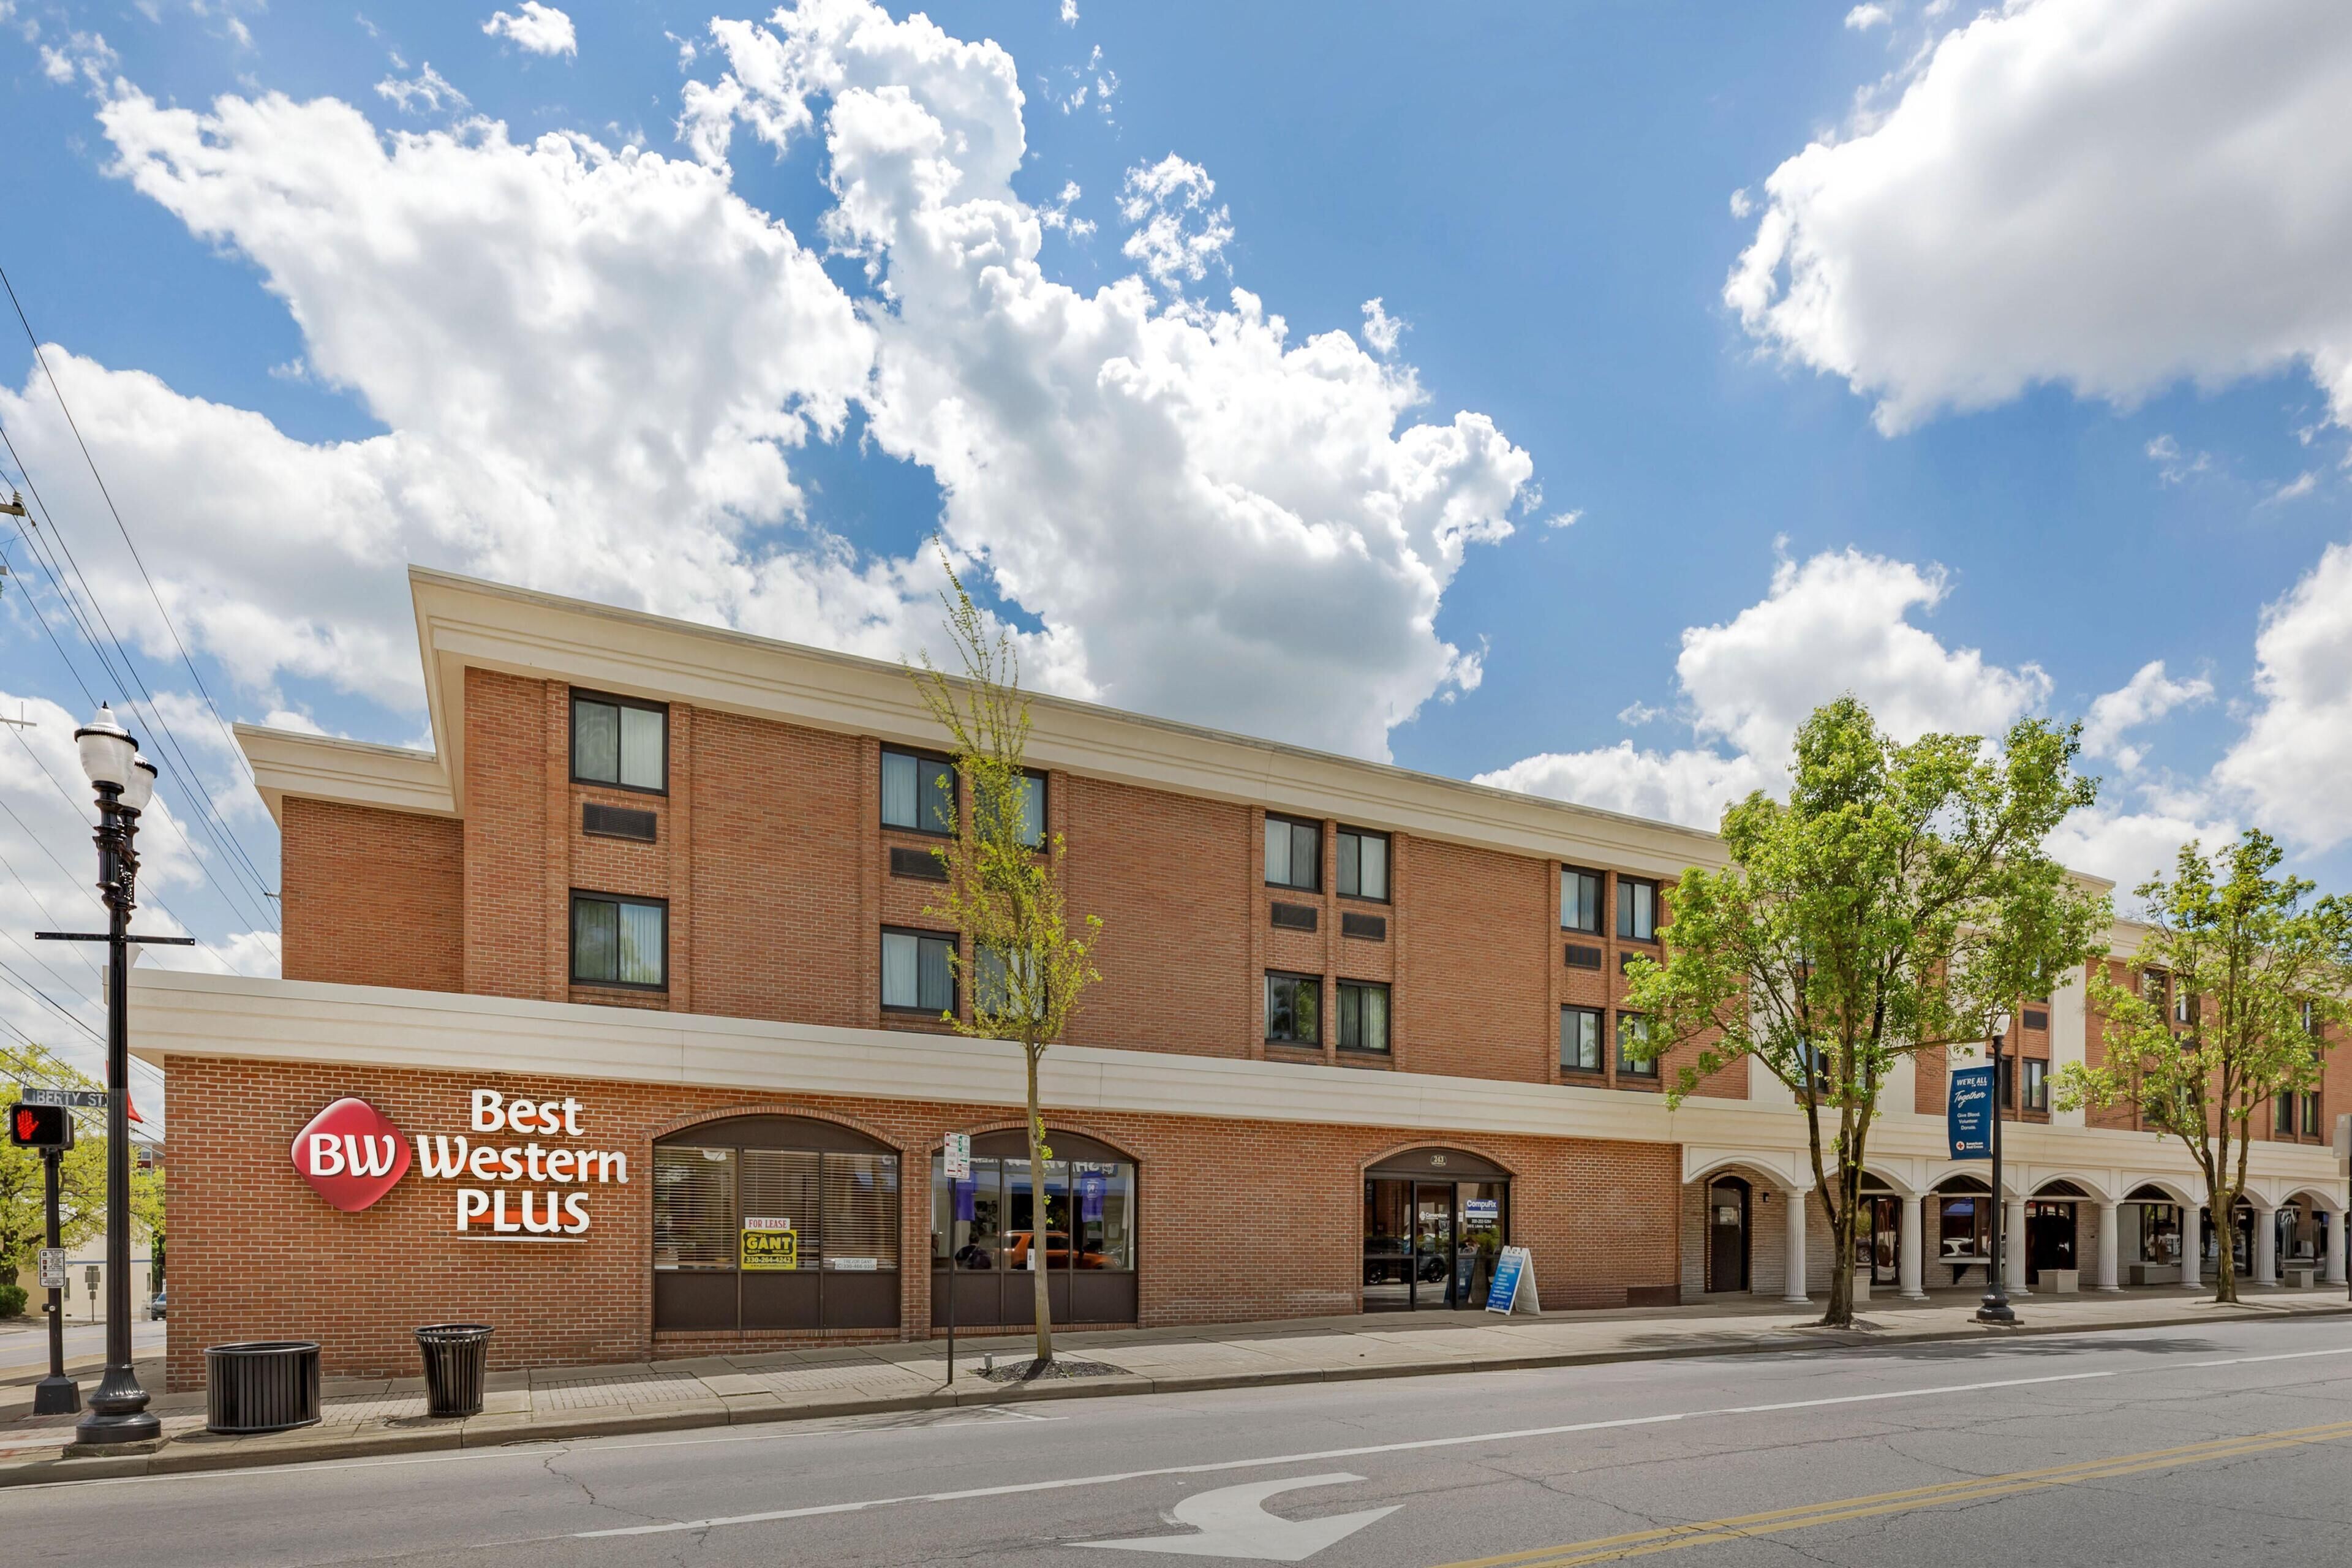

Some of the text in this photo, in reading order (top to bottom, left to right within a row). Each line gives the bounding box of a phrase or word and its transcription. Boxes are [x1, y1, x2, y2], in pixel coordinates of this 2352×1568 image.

[472, 1088, 584, 1136] Best
[1954, 1090, 1986, 1108] Together
[309, 1133, 396, 1177] BW
[416, 1135, 630, 1184] Western
[457, 1189, 590, 1234] PLUS
[1467, 1200, 1497, 1210] CompuFix
[748, 1219, 787, 1228] FOR LEASE
[746, 1237, 791, 1250] GANT
